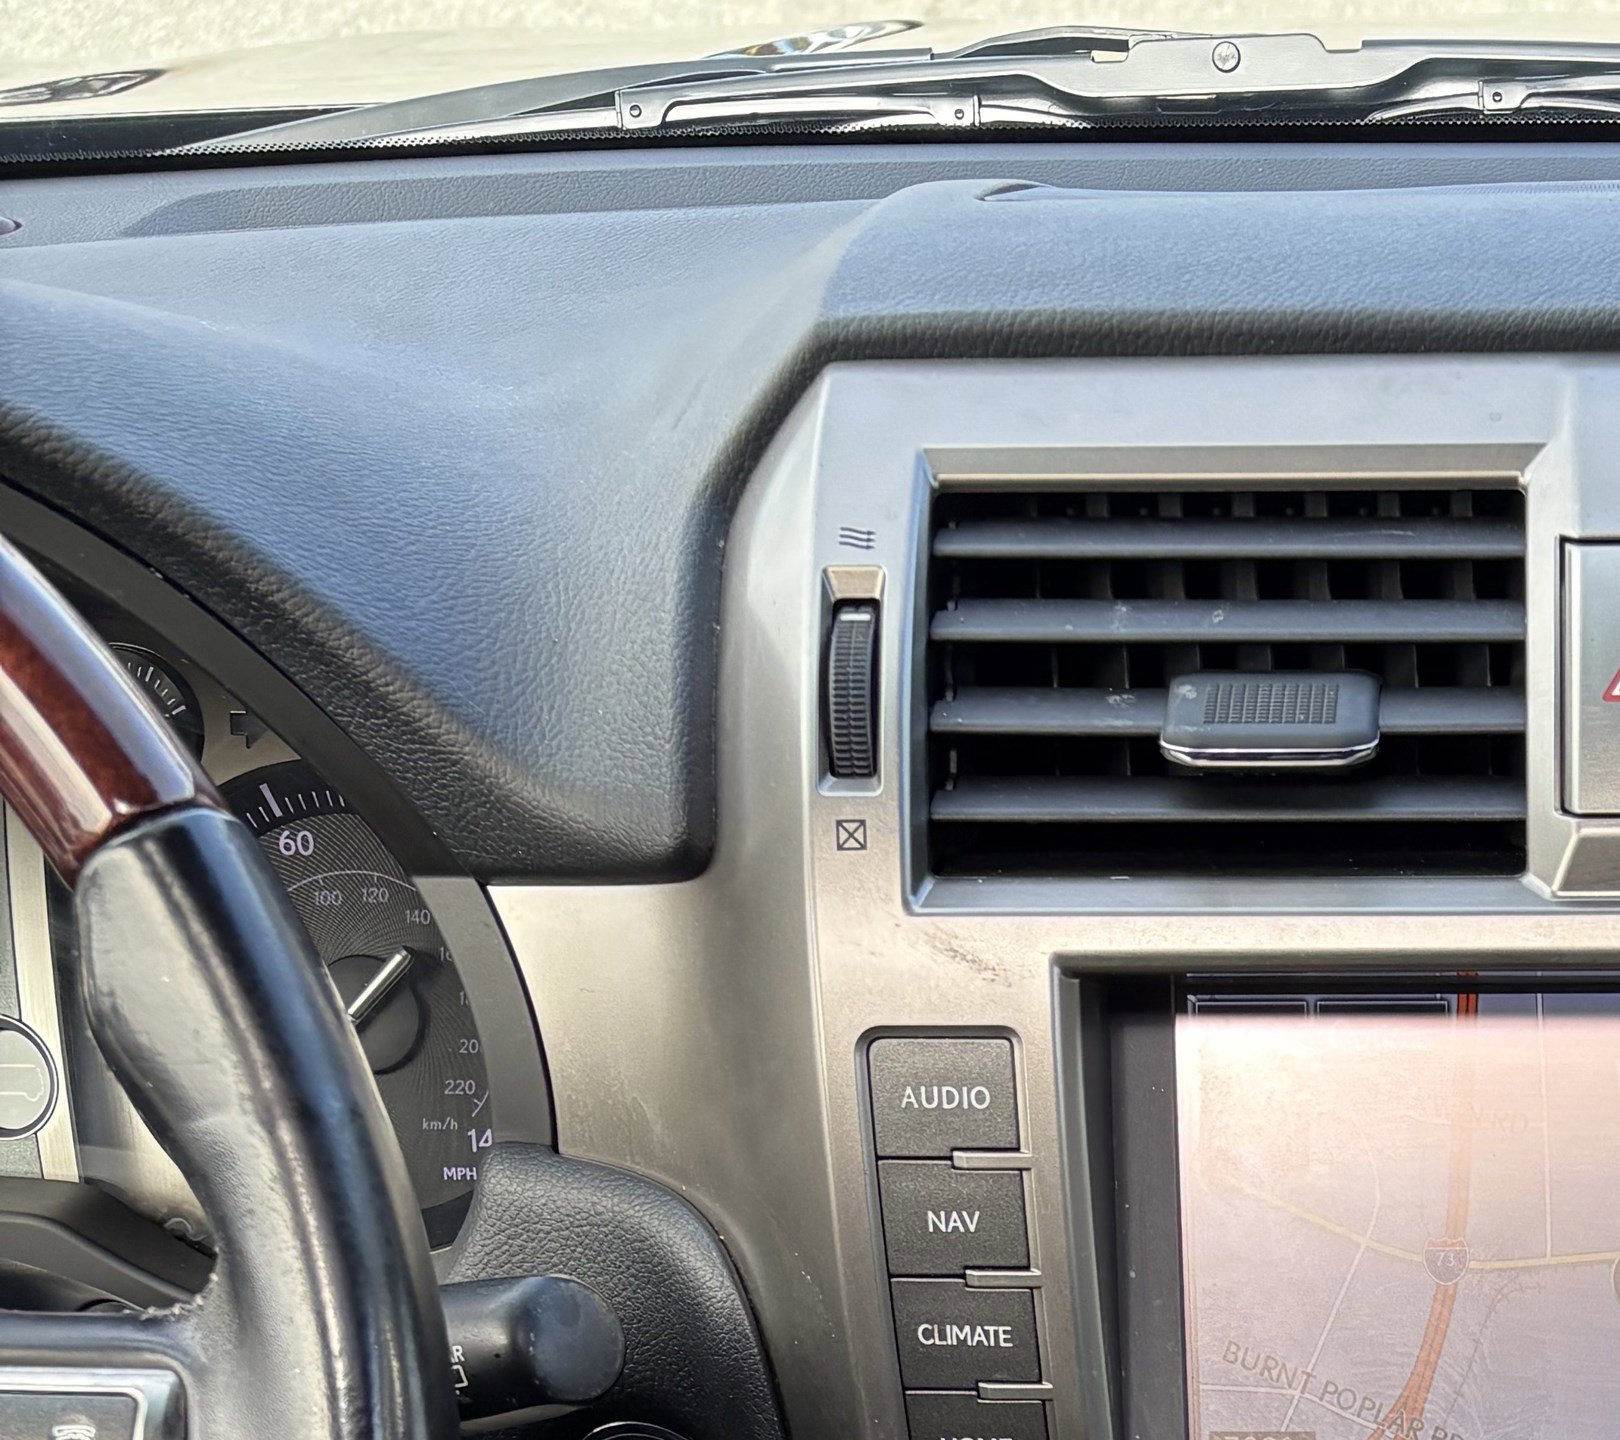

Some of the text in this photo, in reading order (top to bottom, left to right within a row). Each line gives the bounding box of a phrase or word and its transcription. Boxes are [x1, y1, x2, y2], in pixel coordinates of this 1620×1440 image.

[279, 830, 314, 856] 60
[313, 889, 342, 907] 100
[361, 887, 389, 903] 120
[404, 909, 431, 925] 140
[444, 1079, 476, 1095] 220
[901, 1086, 991, 1110] AUDIO
[422, 1117, 459, 1132] km/h
[443, 1167, 477, 1182] MPH
[927, 1211, 980, 1233] NAV
[1437, 1252, 1455, 1267] 73
[917, 1324, 1013, 1348] CLIMATE
[1222, 1339, 1316, 1395] BURNT
